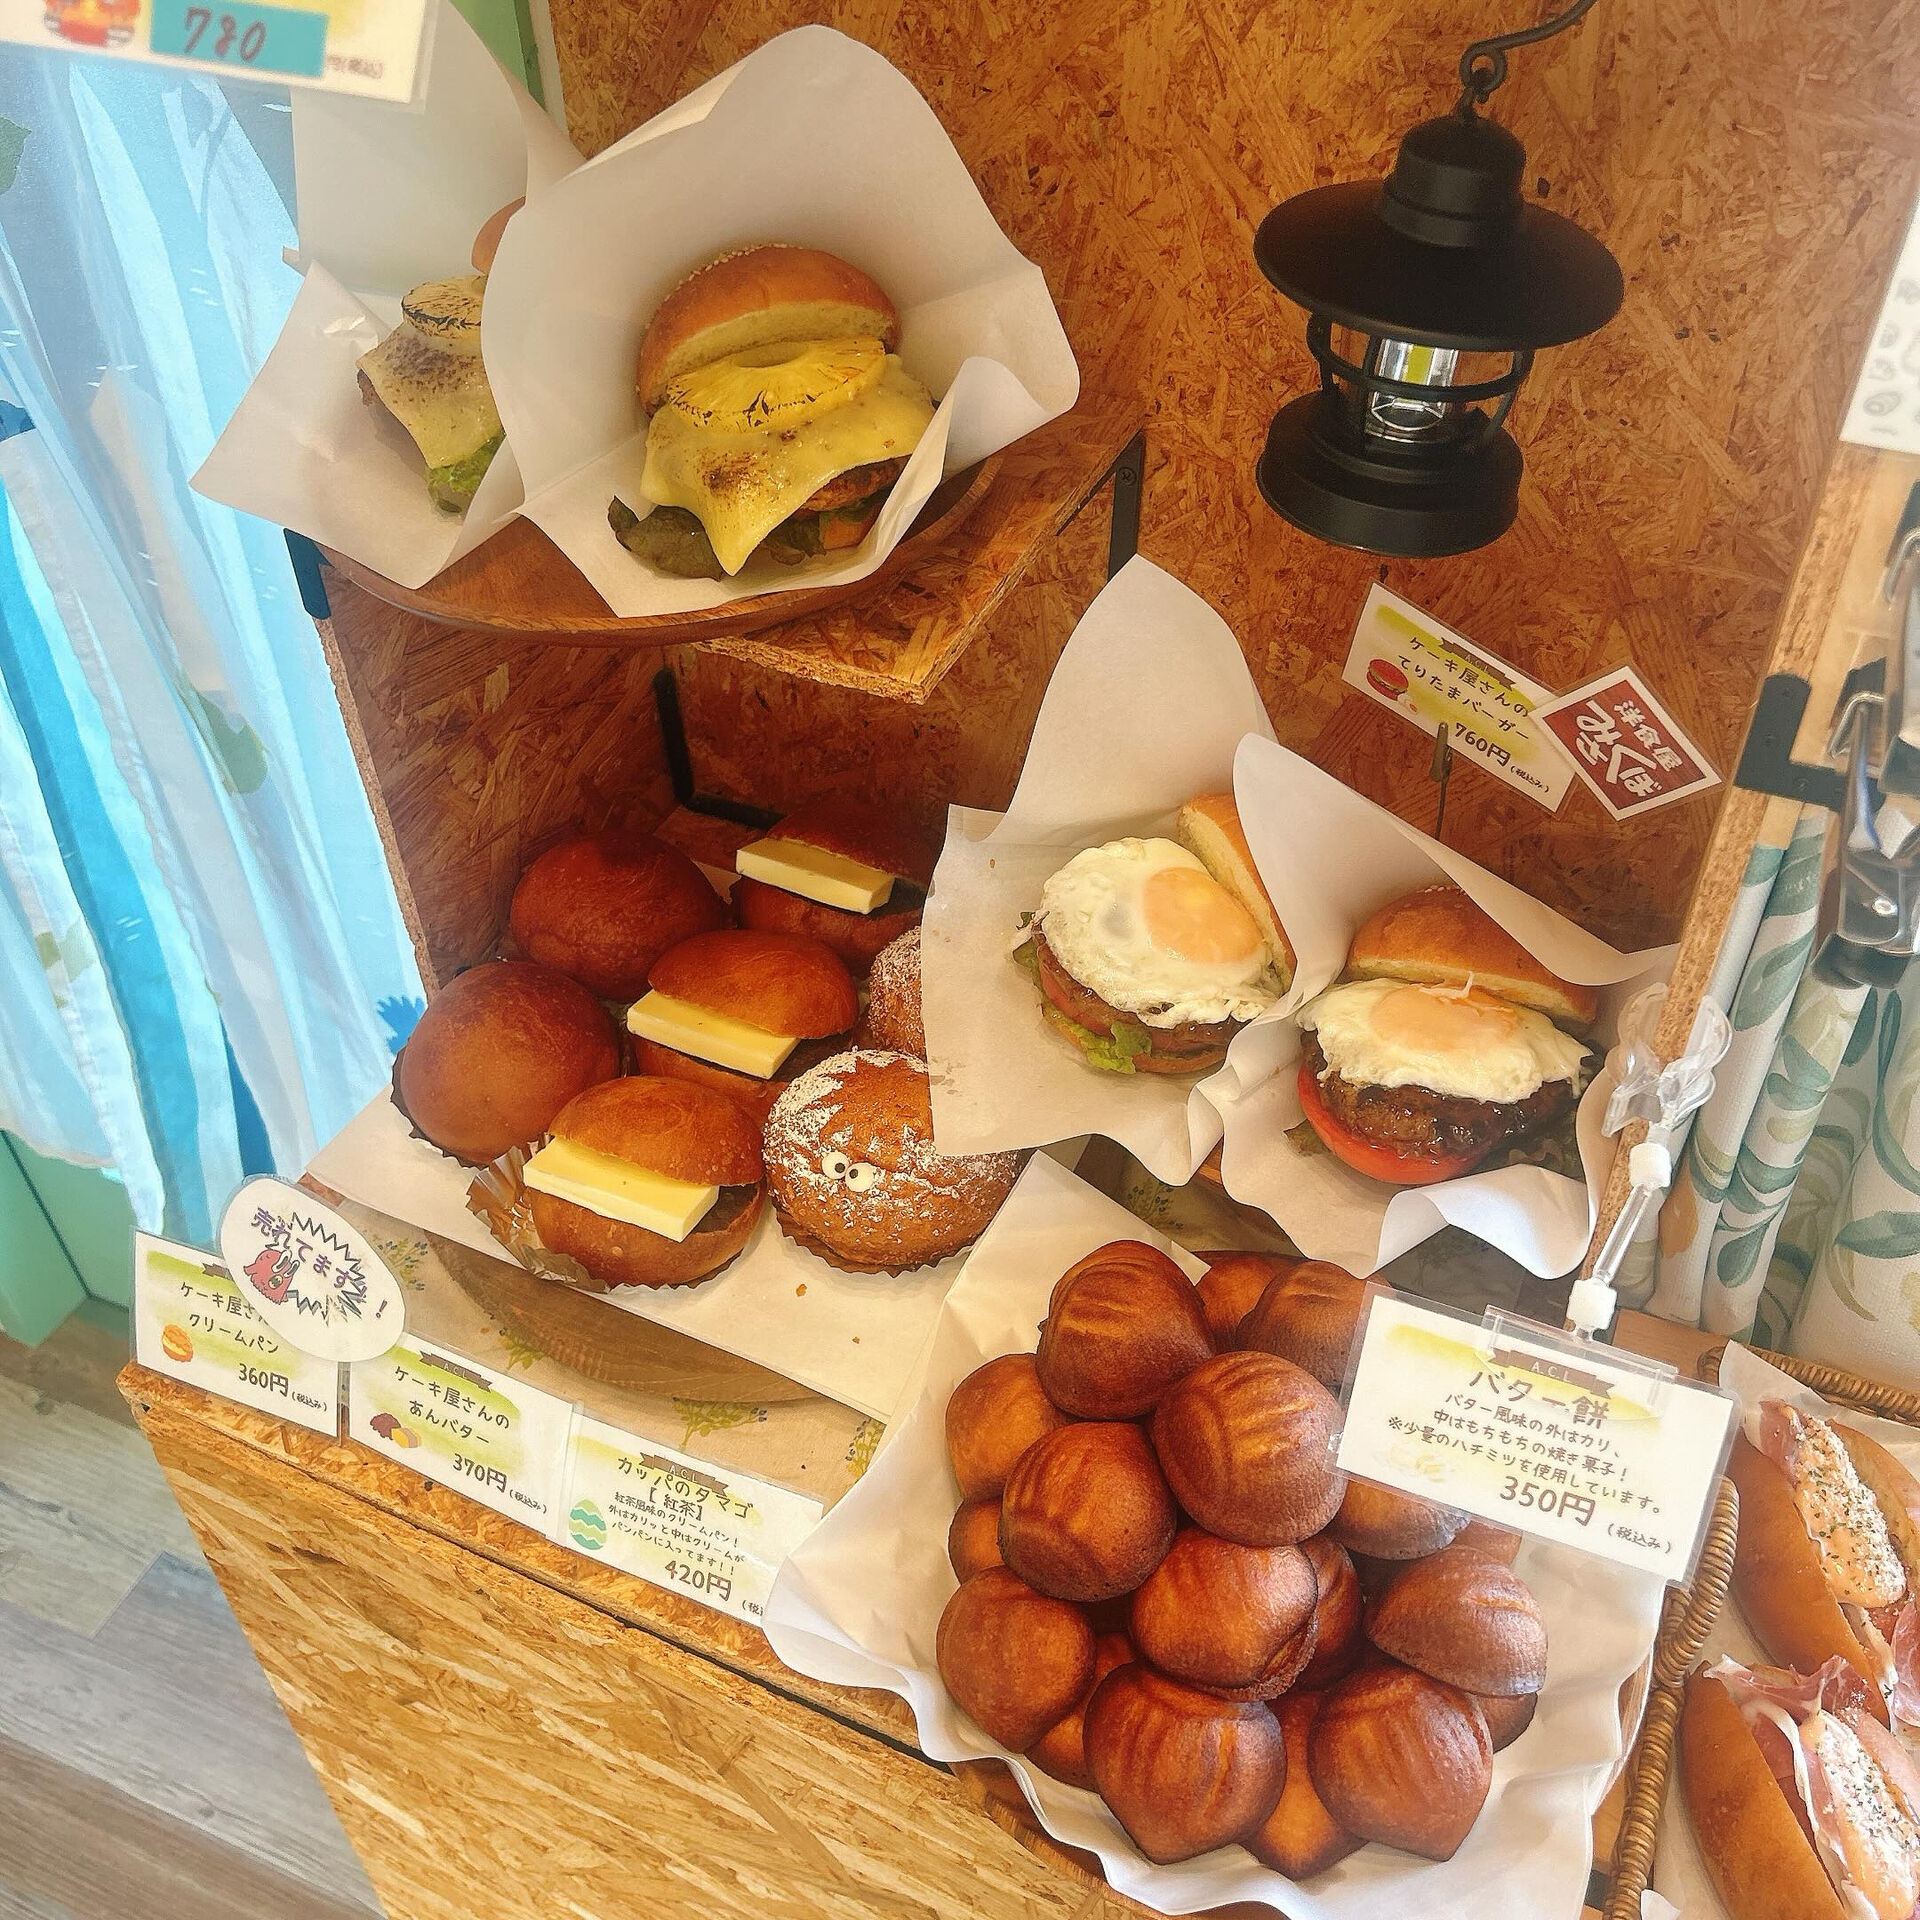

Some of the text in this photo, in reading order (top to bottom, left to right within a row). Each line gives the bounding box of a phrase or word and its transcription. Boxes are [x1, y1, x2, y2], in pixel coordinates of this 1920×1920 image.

[184, 7, 266, 61] 780
[1398, 655, 1529, 740] てりたまバーガー
[1410, 637, 1529, 718] ケーキ屋さんの
[1454, 722, 1511, 767] 760円
[1613, 700, 1683, 772] 洋食屋
[189, 1313, 279, 1353] クリームパン
[238, 1362, 289, 1397] 360円
[395, 1366, 510, 1430] ケーキ屋さんの
[1469, 1371, 1610, 1429] バター餅
[409, 1399, 490, 1445] あんバター
[1433, 1409, 1628, 1482] 中はもちもちの焼き菓子！
[1445, 1393, 1621, 1458] バター風味の外はカリ、
[453, 1453, 507, 1494] 370円
[618, 1457, 754, 1519] カッパのタマゴ
[1499, 1475, 1596, 1527] 350円
[614, 1491, 739, 1548] 紅茶風味のクリームパン！
[664, 1560, 732, 1601] 420円
